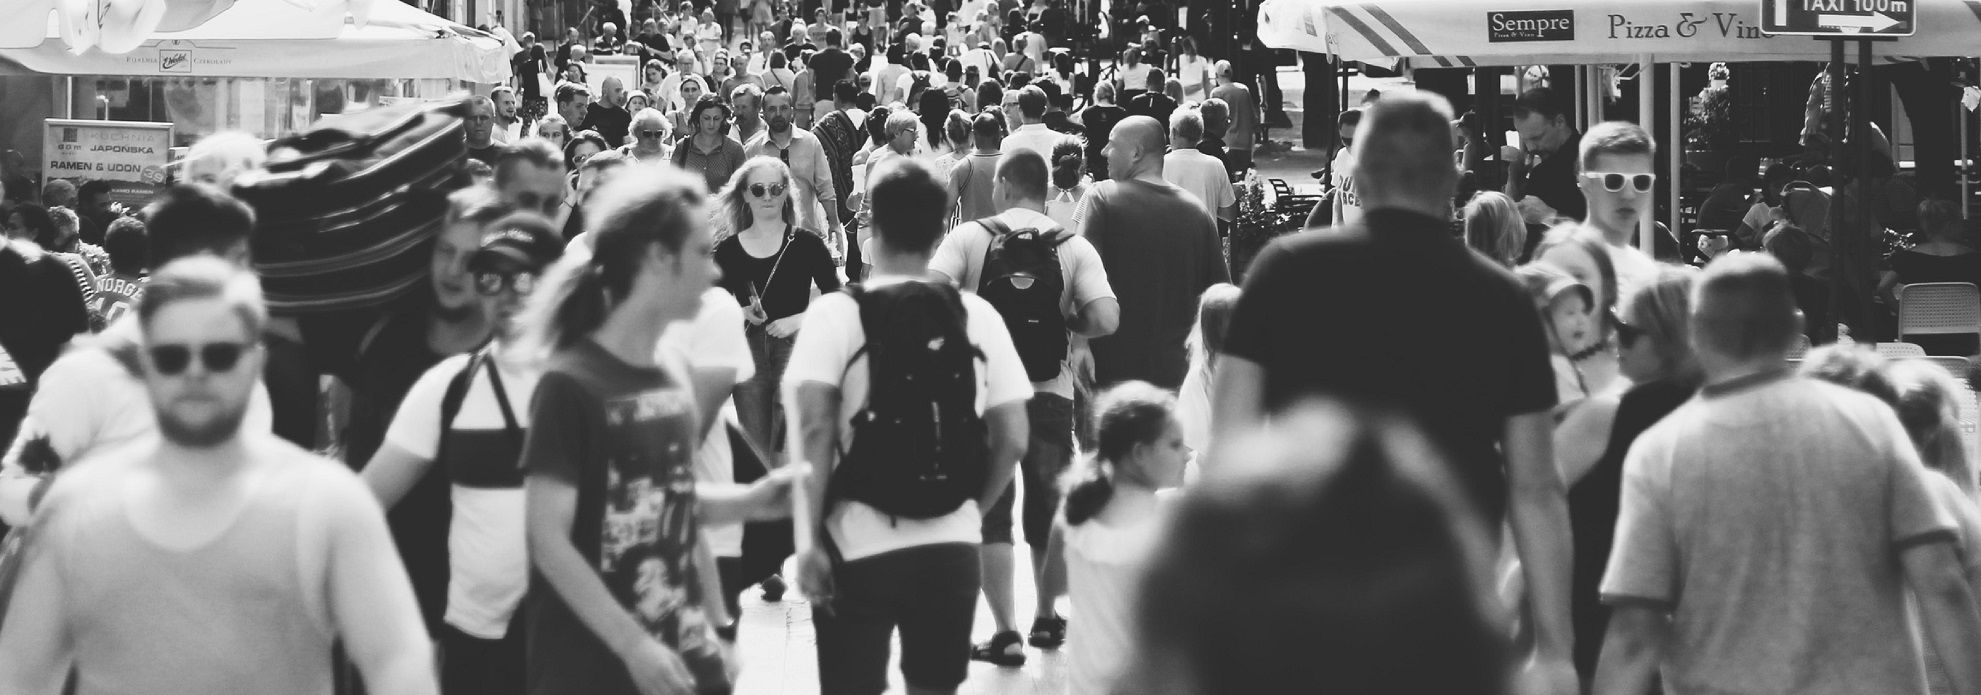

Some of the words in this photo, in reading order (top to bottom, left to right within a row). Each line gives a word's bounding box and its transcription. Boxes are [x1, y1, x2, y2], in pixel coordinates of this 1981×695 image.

[1803, 0, 1845, 11] TAXI
[1492, 13, 1570, 37] Sempre
[1608, 14, 1670, 39] Pizza
[1676, 13, 1708, 38] &
[90, 144, 155, 154] JAPOŃSKA
[50, 160, 92, 171] RAMEN
[96, 163, 104, 171] &
[108, 163, 141, 172] UDON
